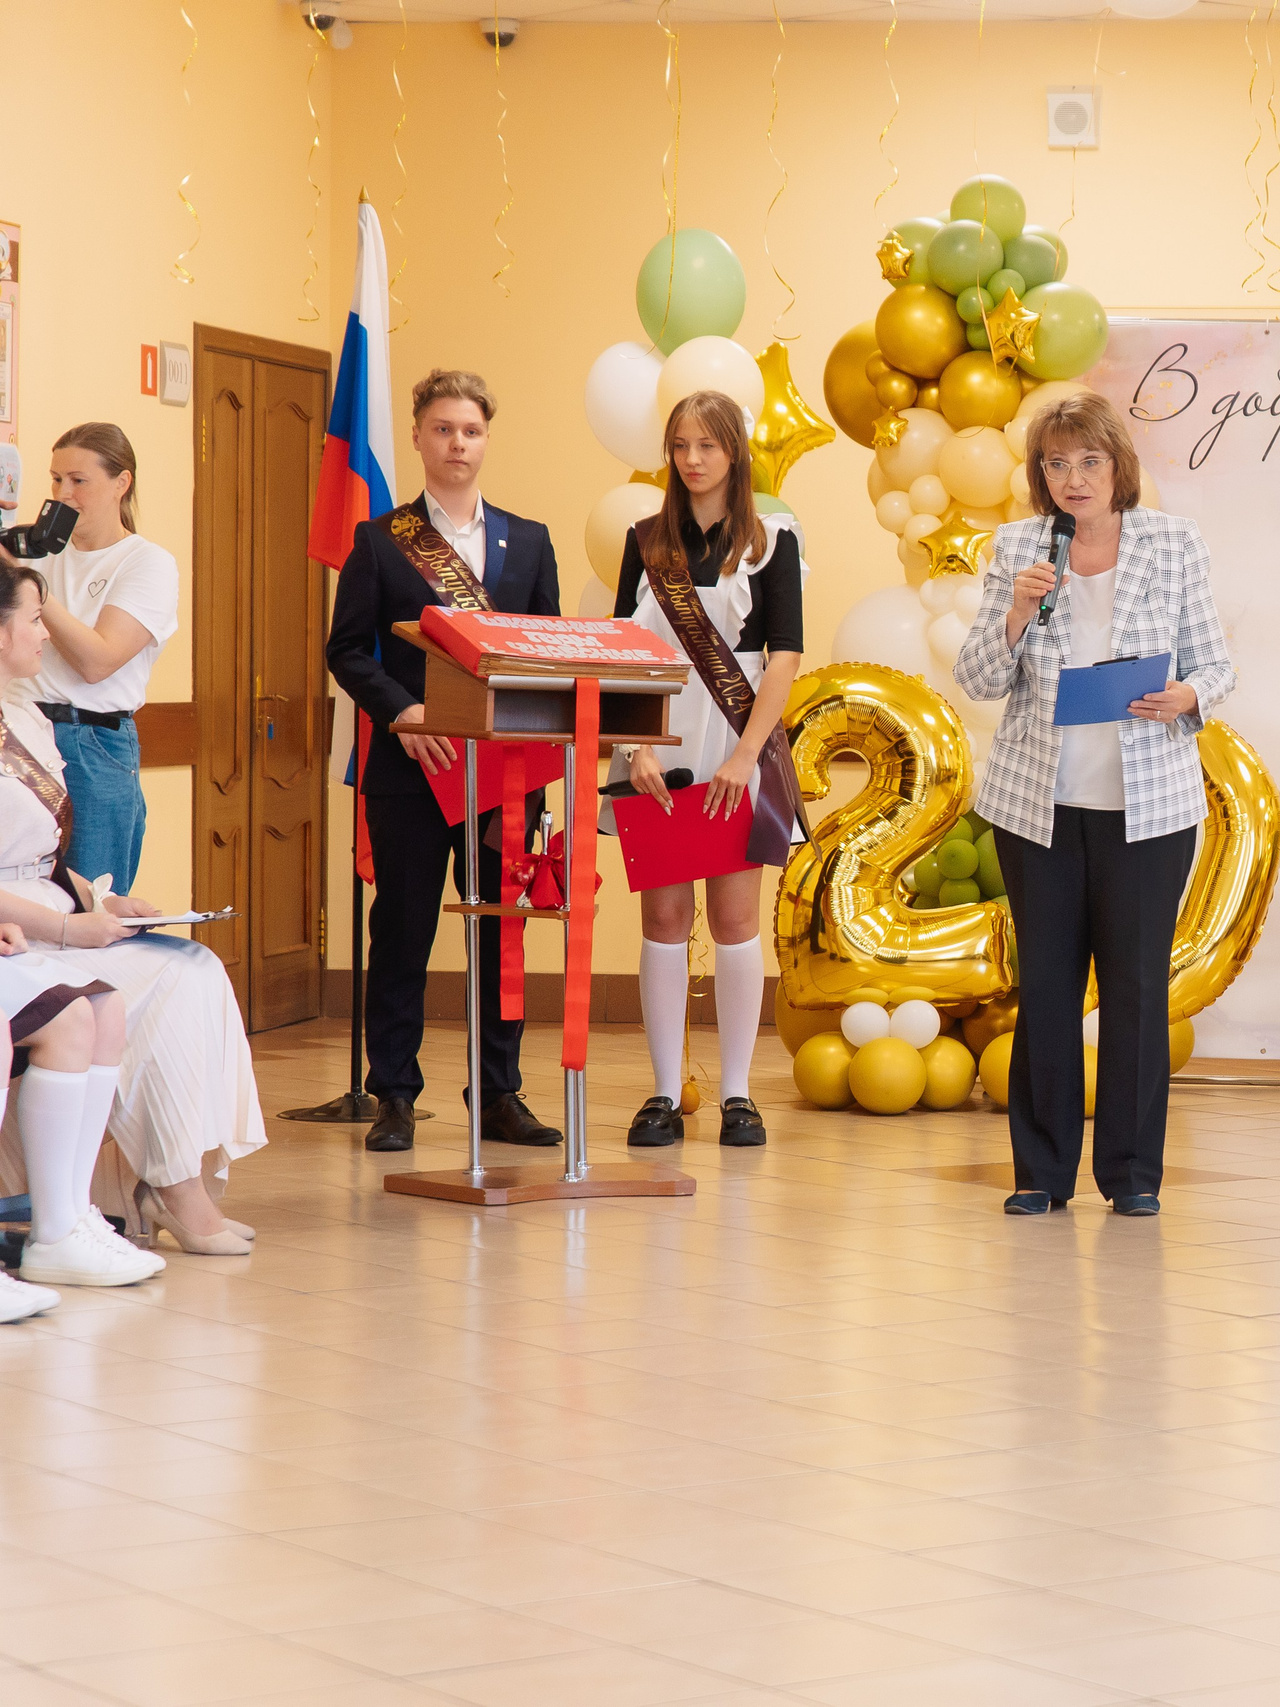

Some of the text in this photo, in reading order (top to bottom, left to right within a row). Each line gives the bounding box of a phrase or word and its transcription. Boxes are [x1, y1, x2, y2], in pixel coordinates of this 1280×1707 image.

[1129, 342, 1199, 422] В
[412, 532, 482, 612] Выпуск
[715, 671, 753, 715] 2024
